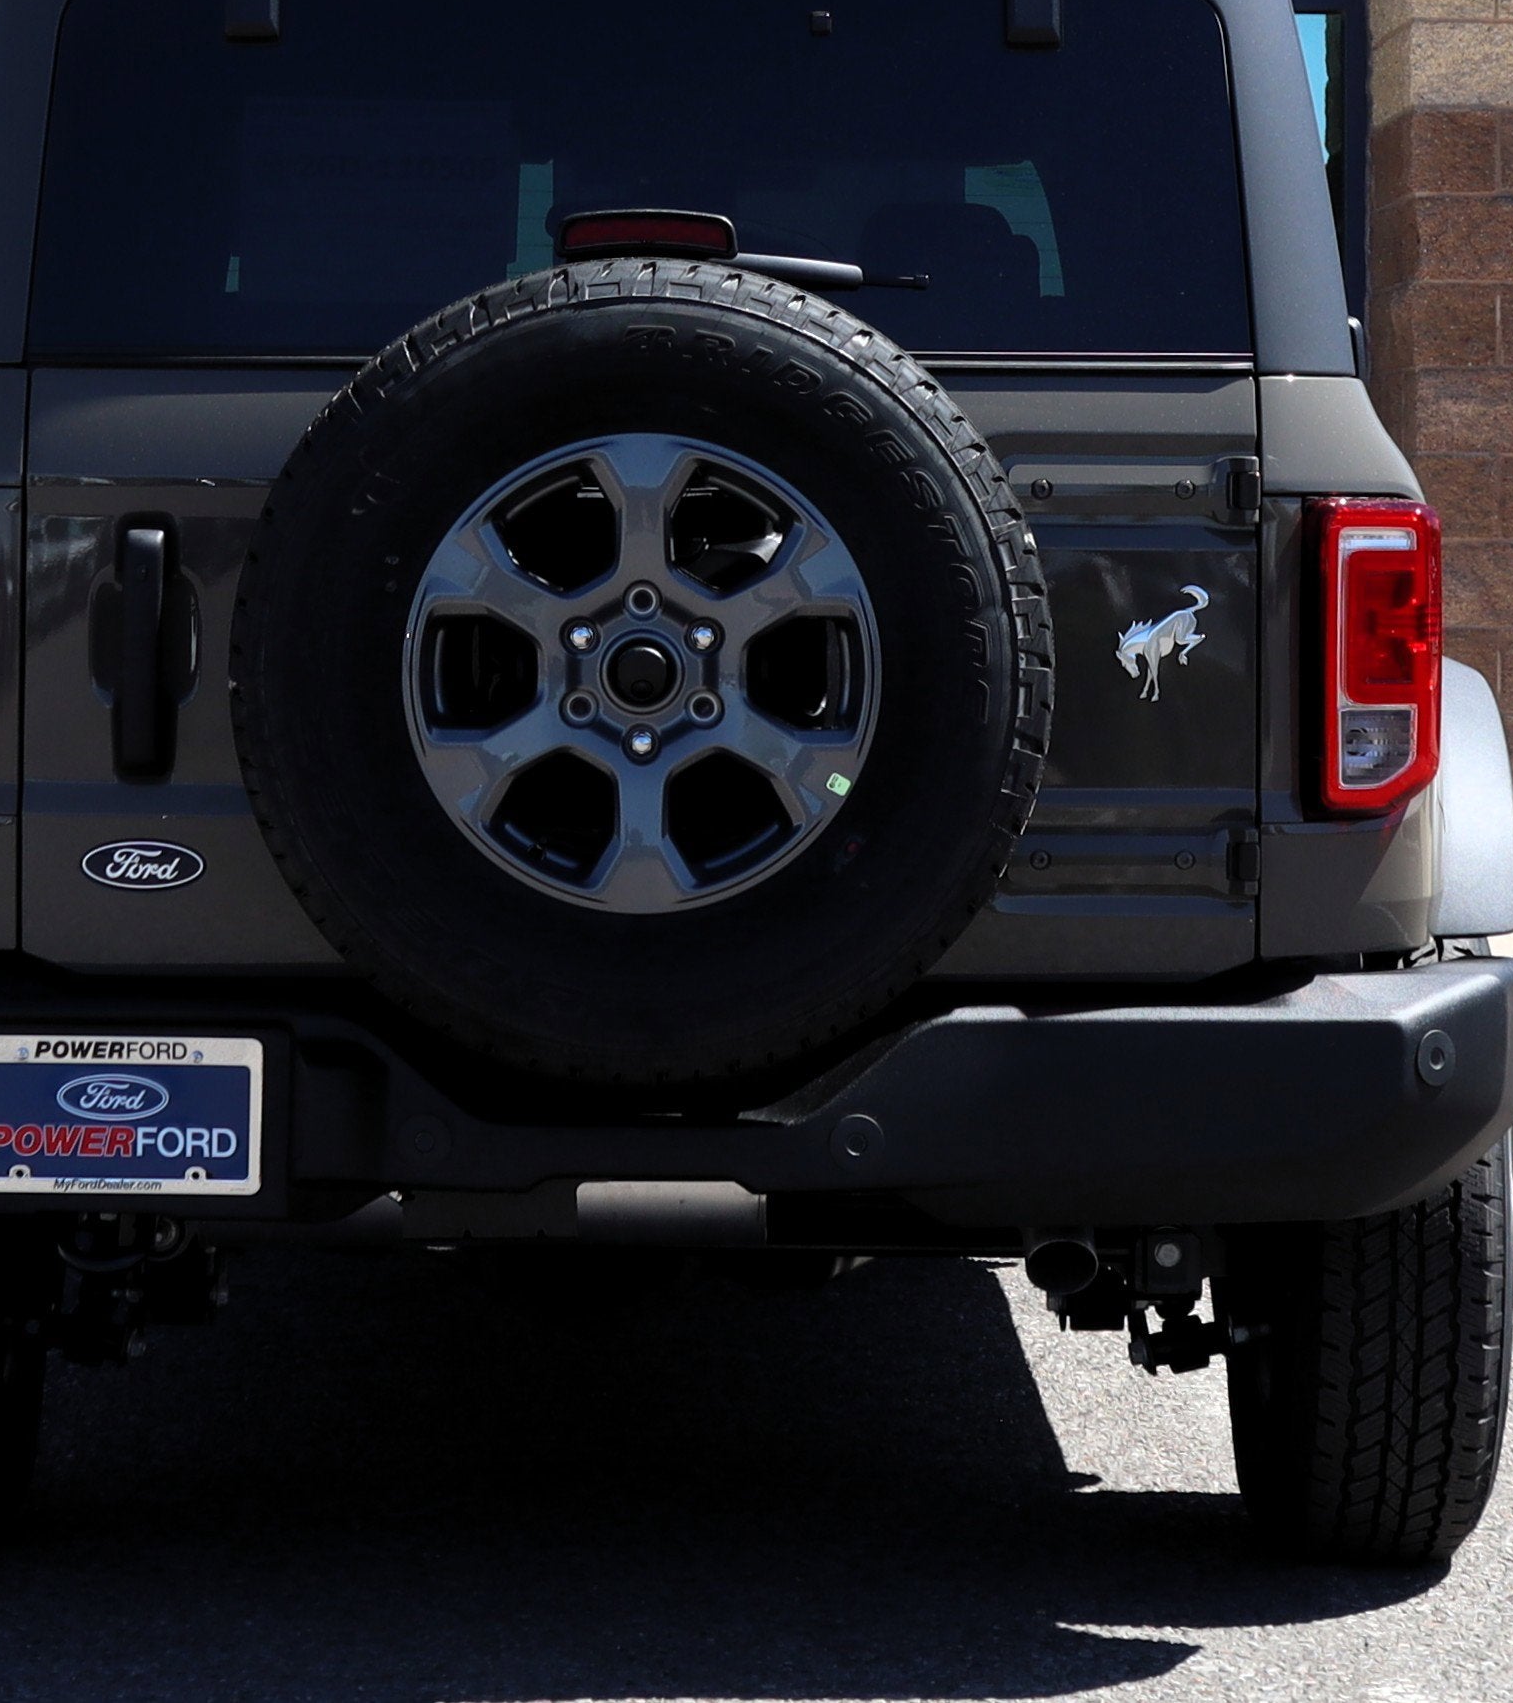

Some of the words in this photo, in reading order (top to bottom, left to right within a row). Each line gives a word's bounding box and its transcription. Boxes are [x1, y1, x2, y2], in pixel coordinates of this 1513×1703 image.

[105, 847, 181, 882] Ford
[79, 1081, 146, 1110] Ford
[53, 1178, 163, 1192] MyFordDealer.com
